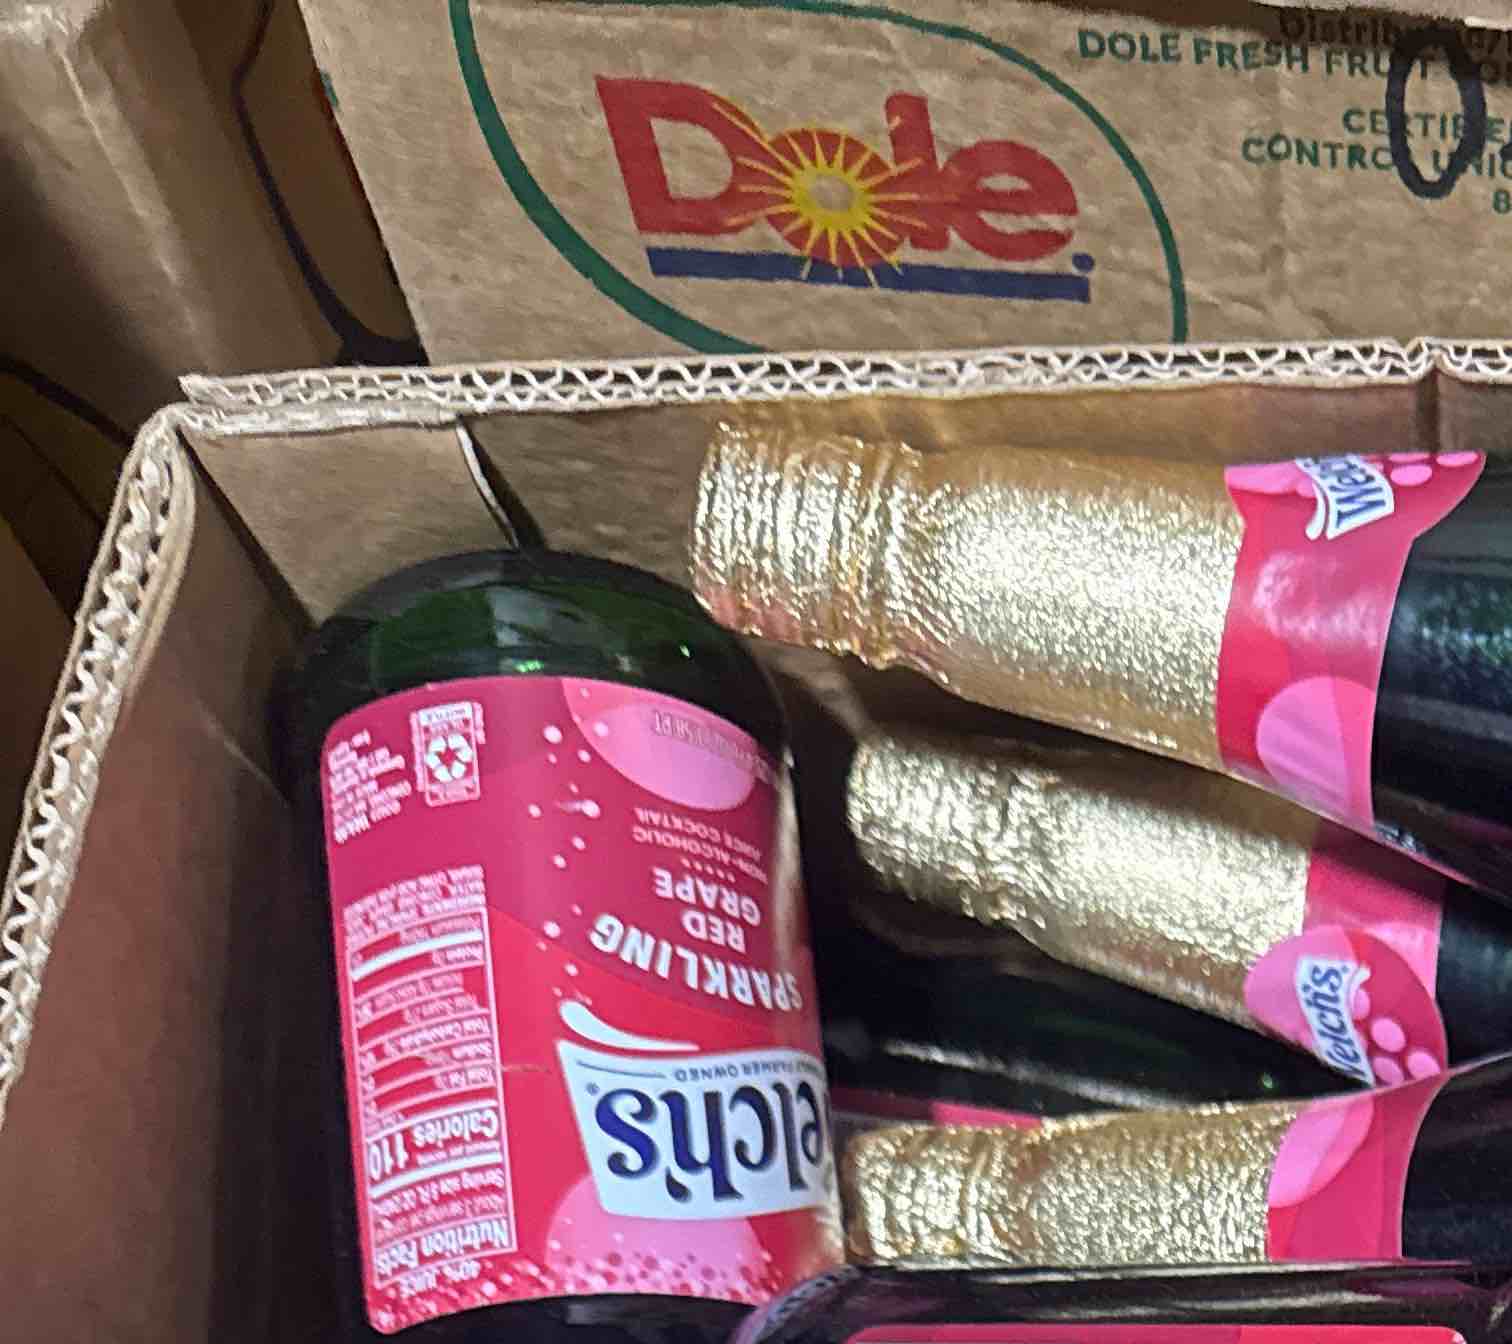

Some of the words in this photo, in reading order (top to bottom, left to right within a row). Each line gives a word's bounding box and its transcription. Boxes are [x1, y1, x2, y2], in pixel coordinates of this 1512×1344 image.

[1192, 35, 1308, 76] FRESH
[1326, 47, 1432, 80] FRUT
[595, 74, 1081, 263] Dole
[1242, 138, 1405, 177] CONTRO
[652, 866, 761, 926] GRAPE
[681, 912, 746, 954] RED
[590, 912, 802, 1011] SPARKLING
